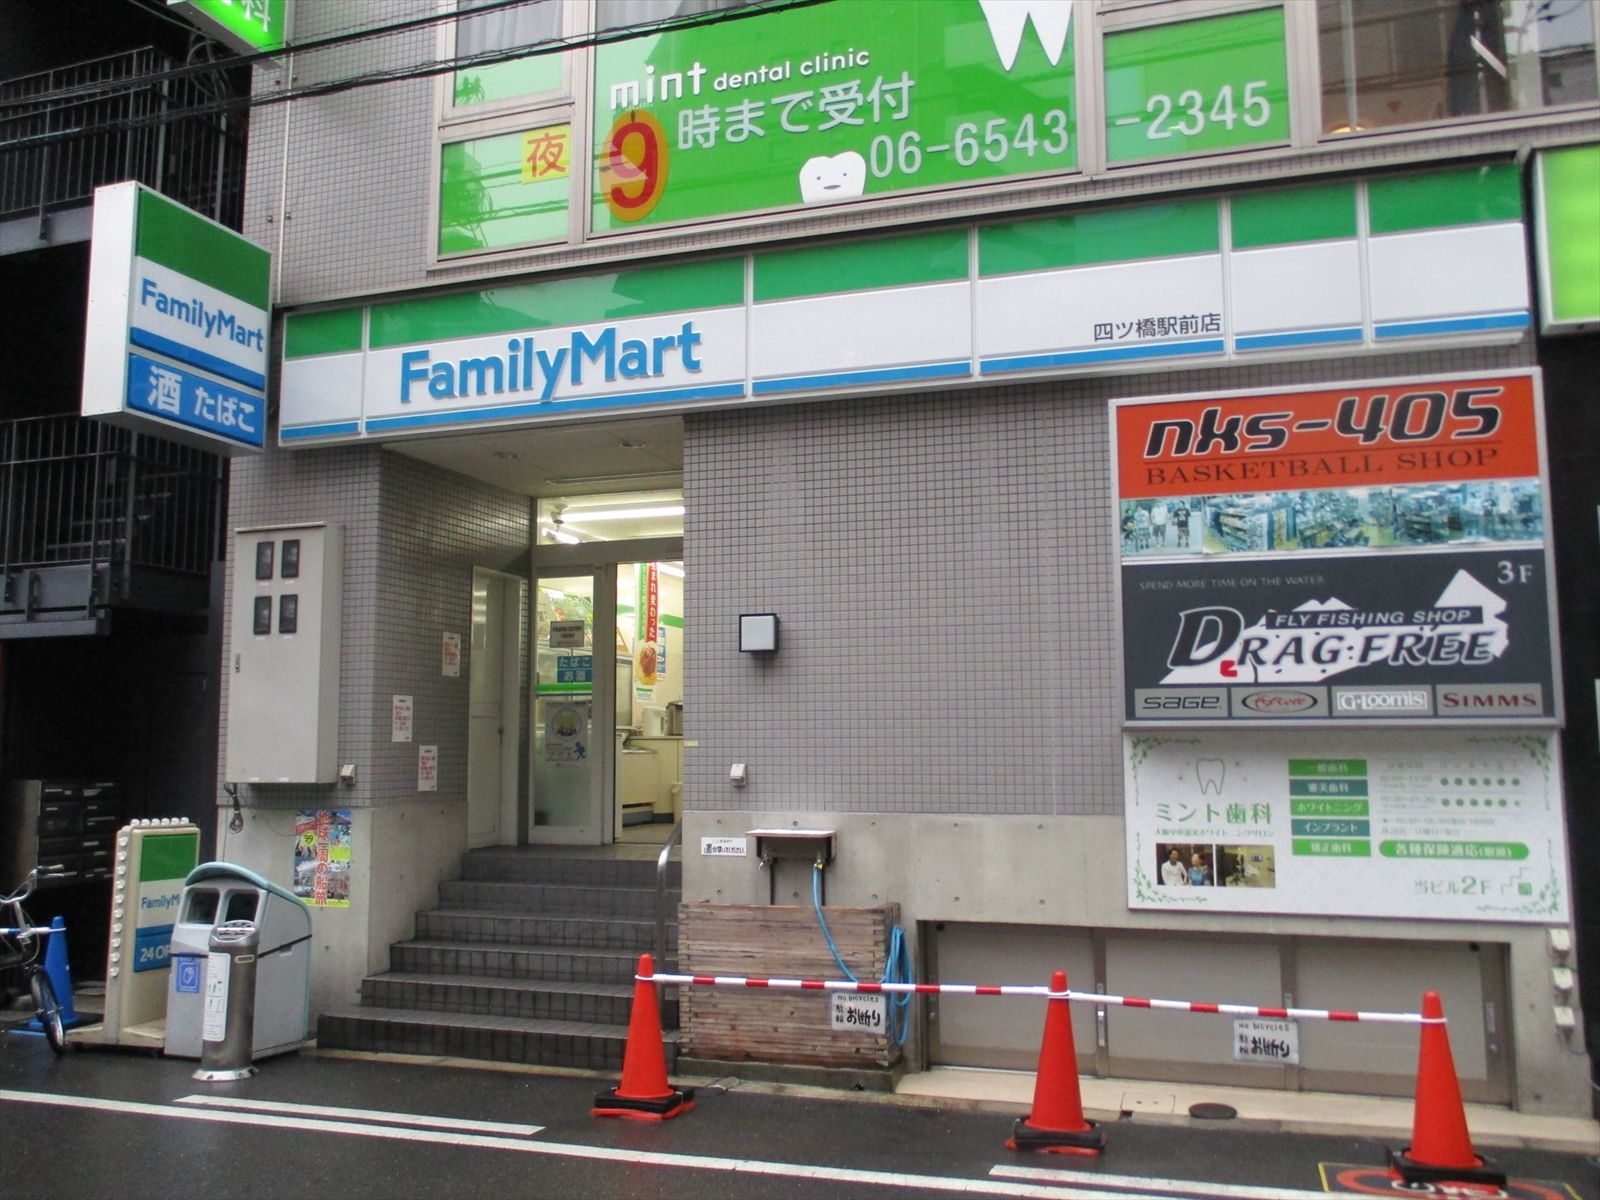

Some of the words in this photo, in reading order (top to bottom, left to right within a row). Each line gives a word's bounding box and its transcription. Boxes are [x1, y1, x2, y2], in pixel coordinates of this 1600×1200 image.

[610, 61, 706, 109] mint
[713, 60, 790, 92] dental
[800, 47, 870, 76] clinic
[526, 132, 568, 177] 夜
[610, 121, 658, 209] 9
[677, 71, 916, 151] 時まで受付
[141, 278, 264, 353] FamilyMart
[1093, 312, 1222, 342] 四ツ橋駅前店
[400, 320, 703, 404] FamilyMart
[147, 365, 183, 416] 酒
[193, 386, 256, 434] たばこ
[1143, 386, 1504, 459] nks-405
[1147, 454, 1384, 486] BASKETBALL
[1396, 446, 1499, 471] SHOP
[1139, 580, 1174, 591] SPEND
[1176, 579, 1208, 590] MORE
[1211, 578, 1238, 588] TIME
[1239, 577, 1258, 588] ON
[1260, 576, 1283, 586] THE
[1285, 575, 1326, 586] WATER
[1496, 559, 1534, 586] 3F
[1274, 612, 1312, 628] FLY
[1316, 609, 1405, 627] FISHING
[1412, 608, 1472, 624] SHOP
[558, 656, 592, 668] たばこ
[563, 670, 586, 682] お酒
[1442, 692, 1537, 708] SIMMS
[1155, 802, 1272, 825] ミント歯科
[1297, 802, 1362, 814] ホワイトニング
[1303, 821, 1359, 833] インプラント
[1414, 875, 1492, 896] 当ビル2F
